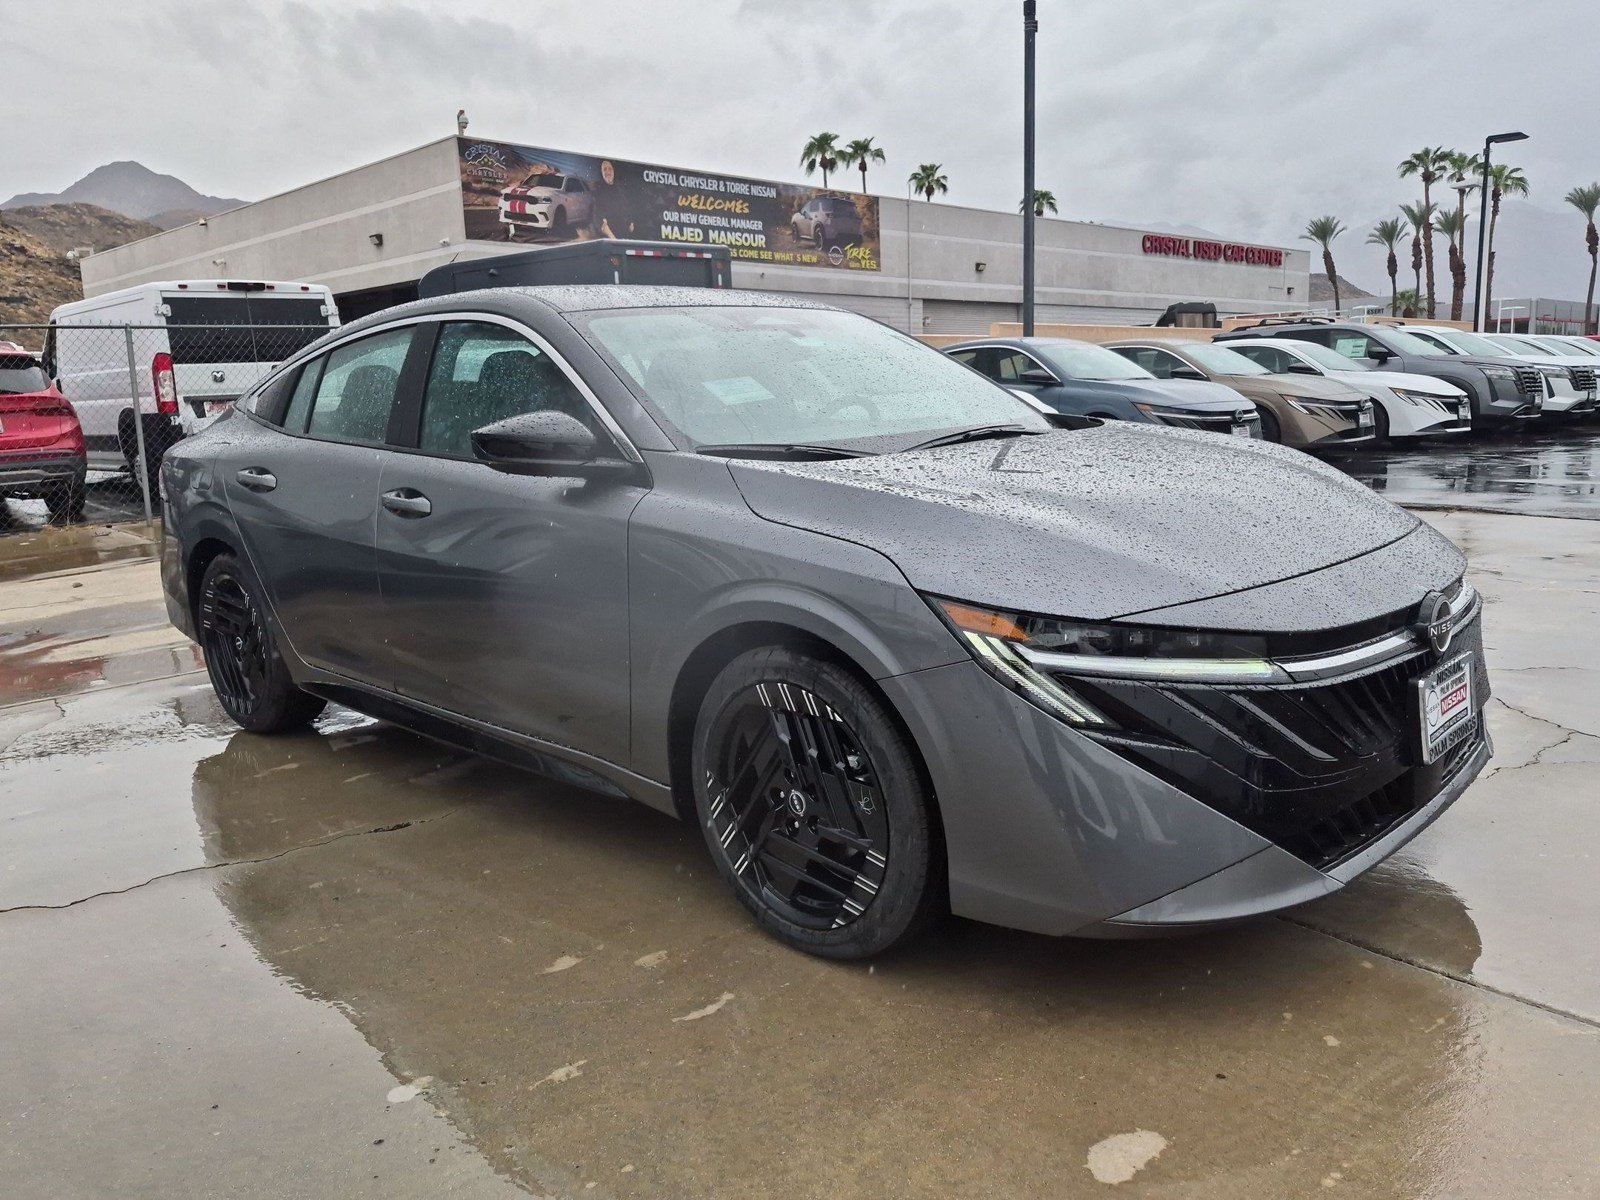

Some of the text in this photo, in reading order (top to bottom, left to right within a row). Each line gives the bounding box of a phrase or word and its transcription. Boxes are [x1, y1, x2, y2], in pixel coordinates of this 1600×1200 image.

[464, 144, 506, 162] CRYSTAL
[643, 170, 776, 199] CRYSTAL CHRYSLER & TORRE NISSAN
[678, 194, 749, 214] WELCOMES
[663, 211, 763, 231] OUR NEW GENERAL MANAGER
[661, 224, 766, 248] MAJED MANSOUR
[739, 249, 759, 259] COME
[760, 251, 773, 260] SEE
[802, 254, 817, 263] NEW
[1142, 235, 1282, 266] CRYSTAL USED CAR CENTER
[861, 260, 877, 269] YES
[1437, 660, 1461, 685] NISSAN
[1441, 687, 1466, 712] NISSAN
[1430, 737, 1448, 762] PALM
[1449, 716, 1477, 746] SPRINGS
